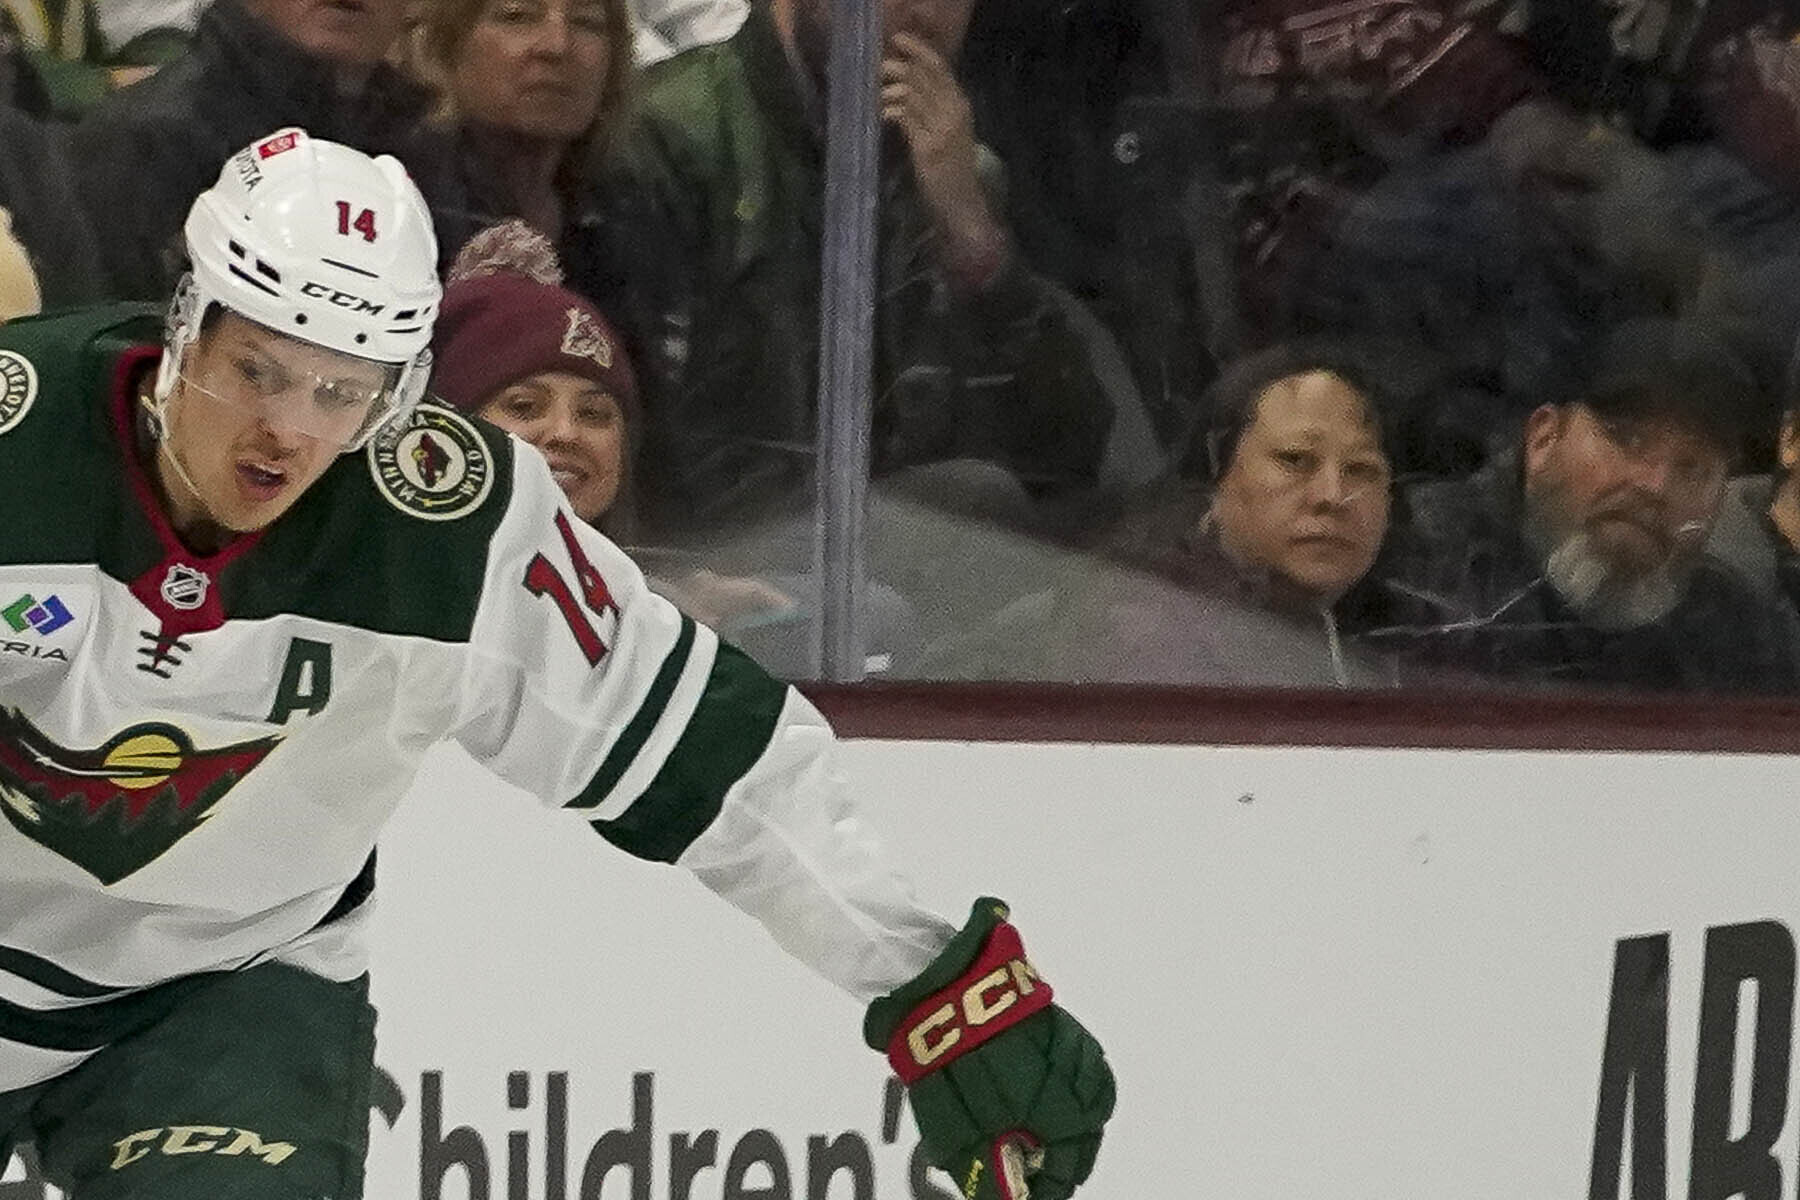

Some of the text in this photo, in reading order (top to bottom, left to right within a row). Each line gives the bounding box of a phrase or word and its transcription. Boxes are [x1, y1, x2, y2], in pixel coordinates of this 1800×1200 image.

[335, 200, 377, 243] 14
[300, 281, 385, 316] CCM
[521, 506, 622, 670] 14
[265, 637, 333, 725] A
[109, 1125, 298, 1171] CCM
